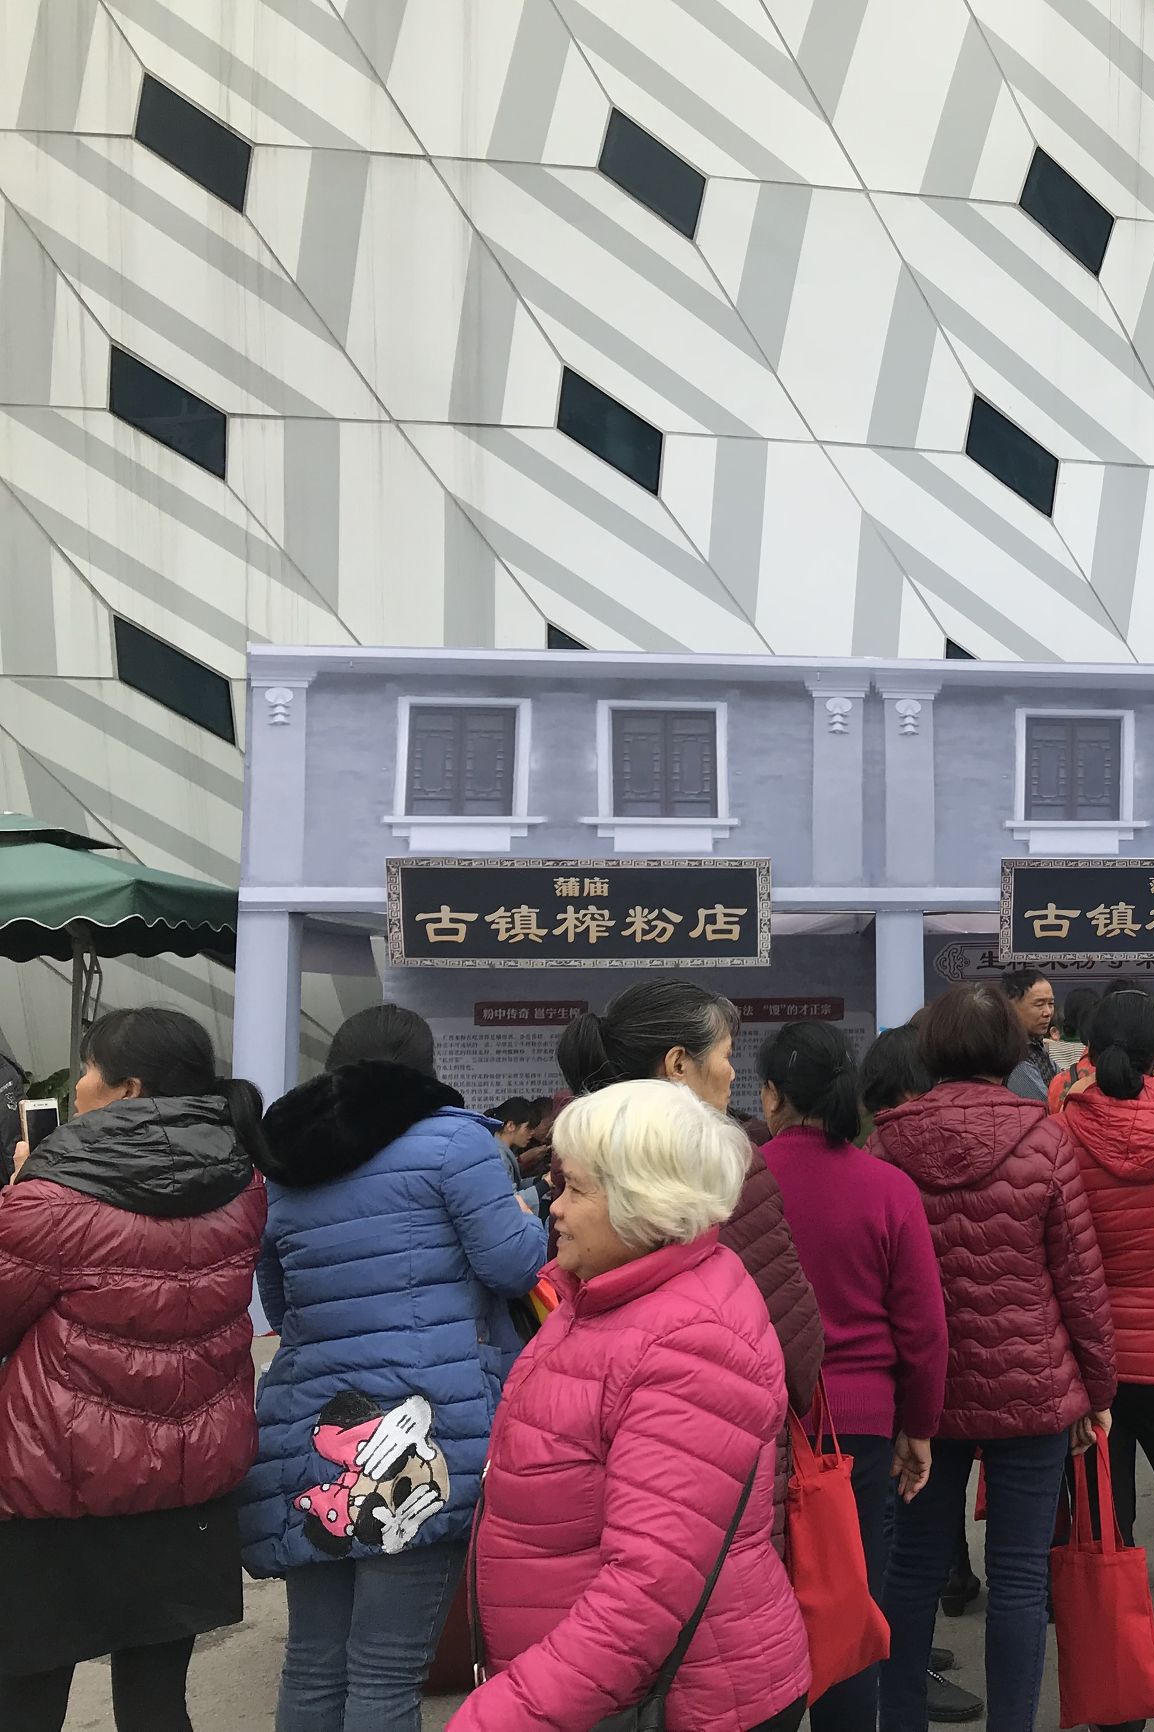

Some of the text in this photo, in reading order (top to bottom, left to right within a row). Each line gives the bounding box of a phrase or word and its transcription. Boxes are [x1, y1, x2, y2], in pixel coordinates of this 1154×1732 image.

[553, 876, 610, 897] 蒲庙
[415, 903, 748, 944] 古镇榨粉店
[482, 1007, 529, 1020] 粉中传奇
